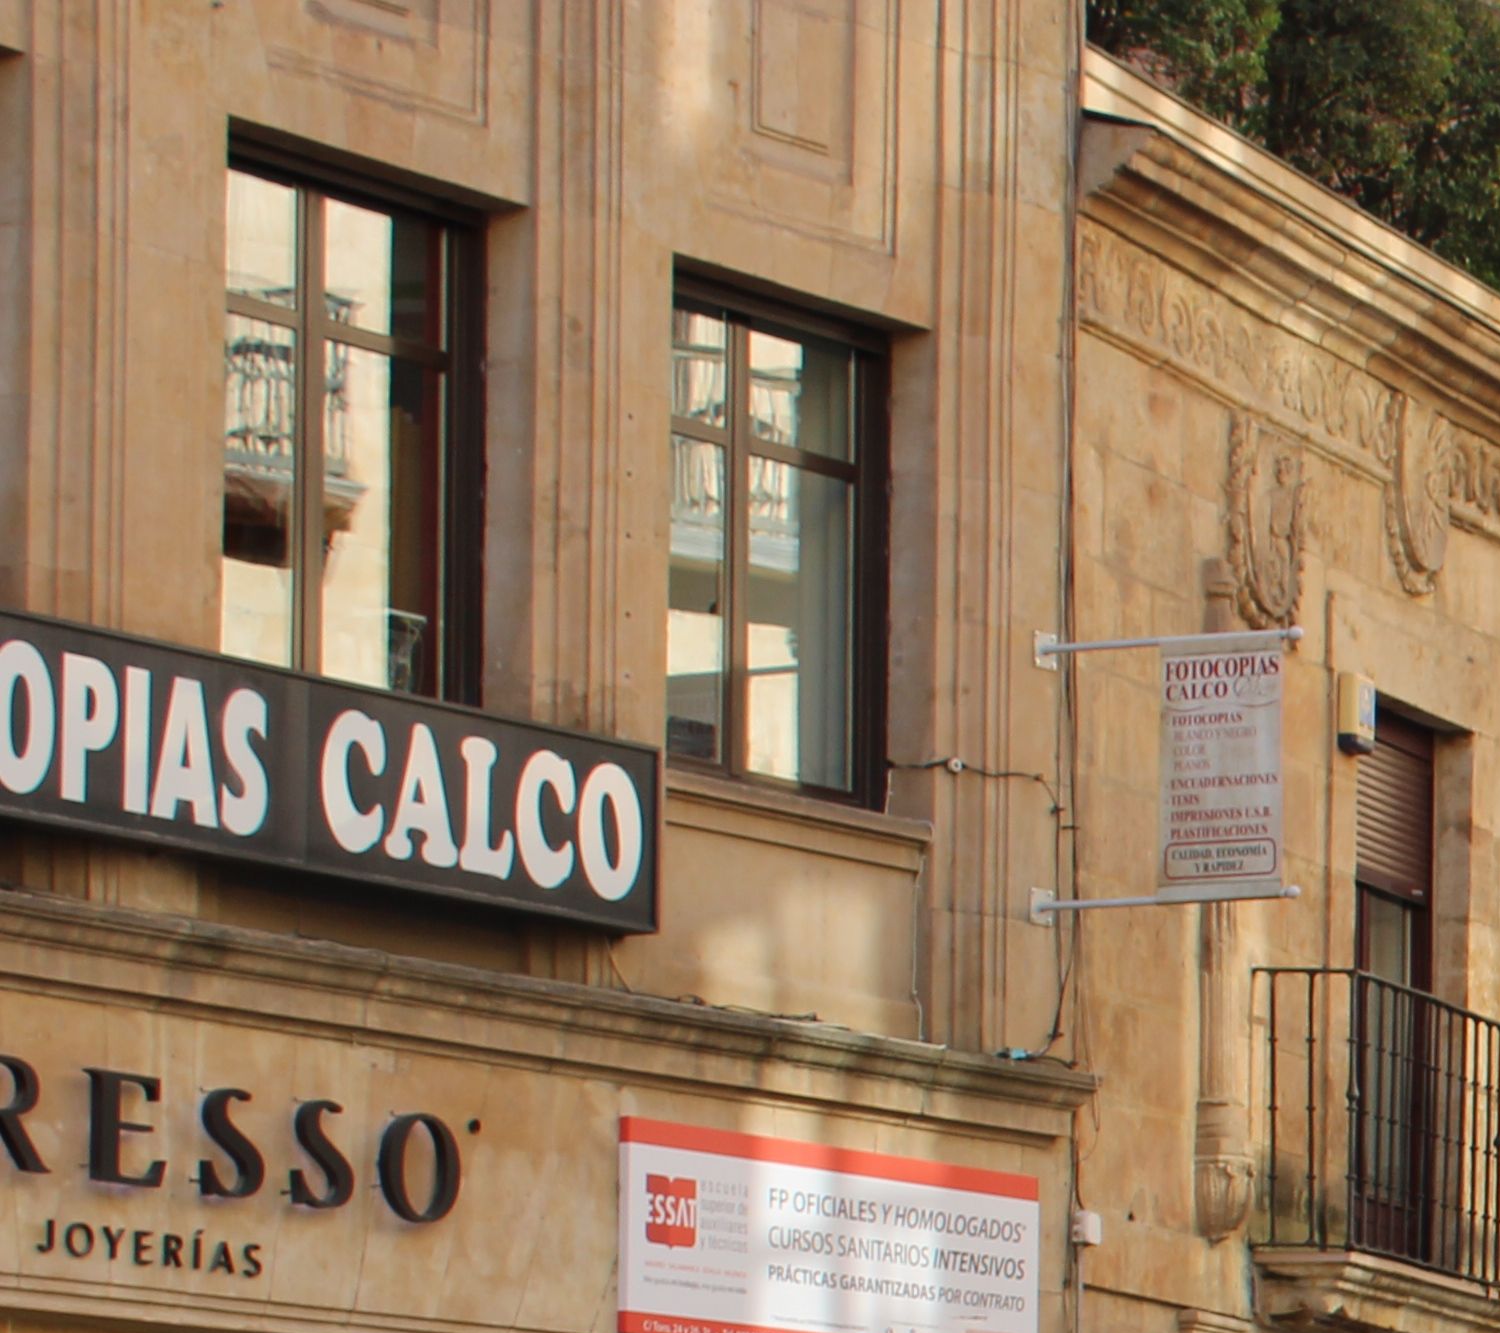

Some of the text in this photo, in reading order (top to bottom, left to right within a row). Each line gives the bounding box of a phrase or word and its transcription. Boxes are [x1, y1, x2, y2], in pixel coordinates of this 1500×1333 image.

[1165, 656, 1279, 681] FOTOCOPIAS
[1165, 681, 1229, 701] CALCO
[1172, 712, 1243, 727] FOTOCOPIAS
[321, 709, 643, 902] CALCO
[647, 1194, 696, 1229] ESSAT
[769, 1188, 789, 1210] FP
[793, 1191, 877, 1224] OFICIALES
[881, 1203, 894, 1224] Y
[36, 1219, 264, 1278] JOYERÍAS
[768, 1226, 1025, 1281] CURSOS SANITARIOS INTENSIVOS
[768, 1263, 837, 1290] PRÁCTICAS
[840, 1274, 936, 1302] GARANTIZADAS
[938, 1286, 962, 1306] POR
[963, 1288, 1025, 1313] CONTRATO
